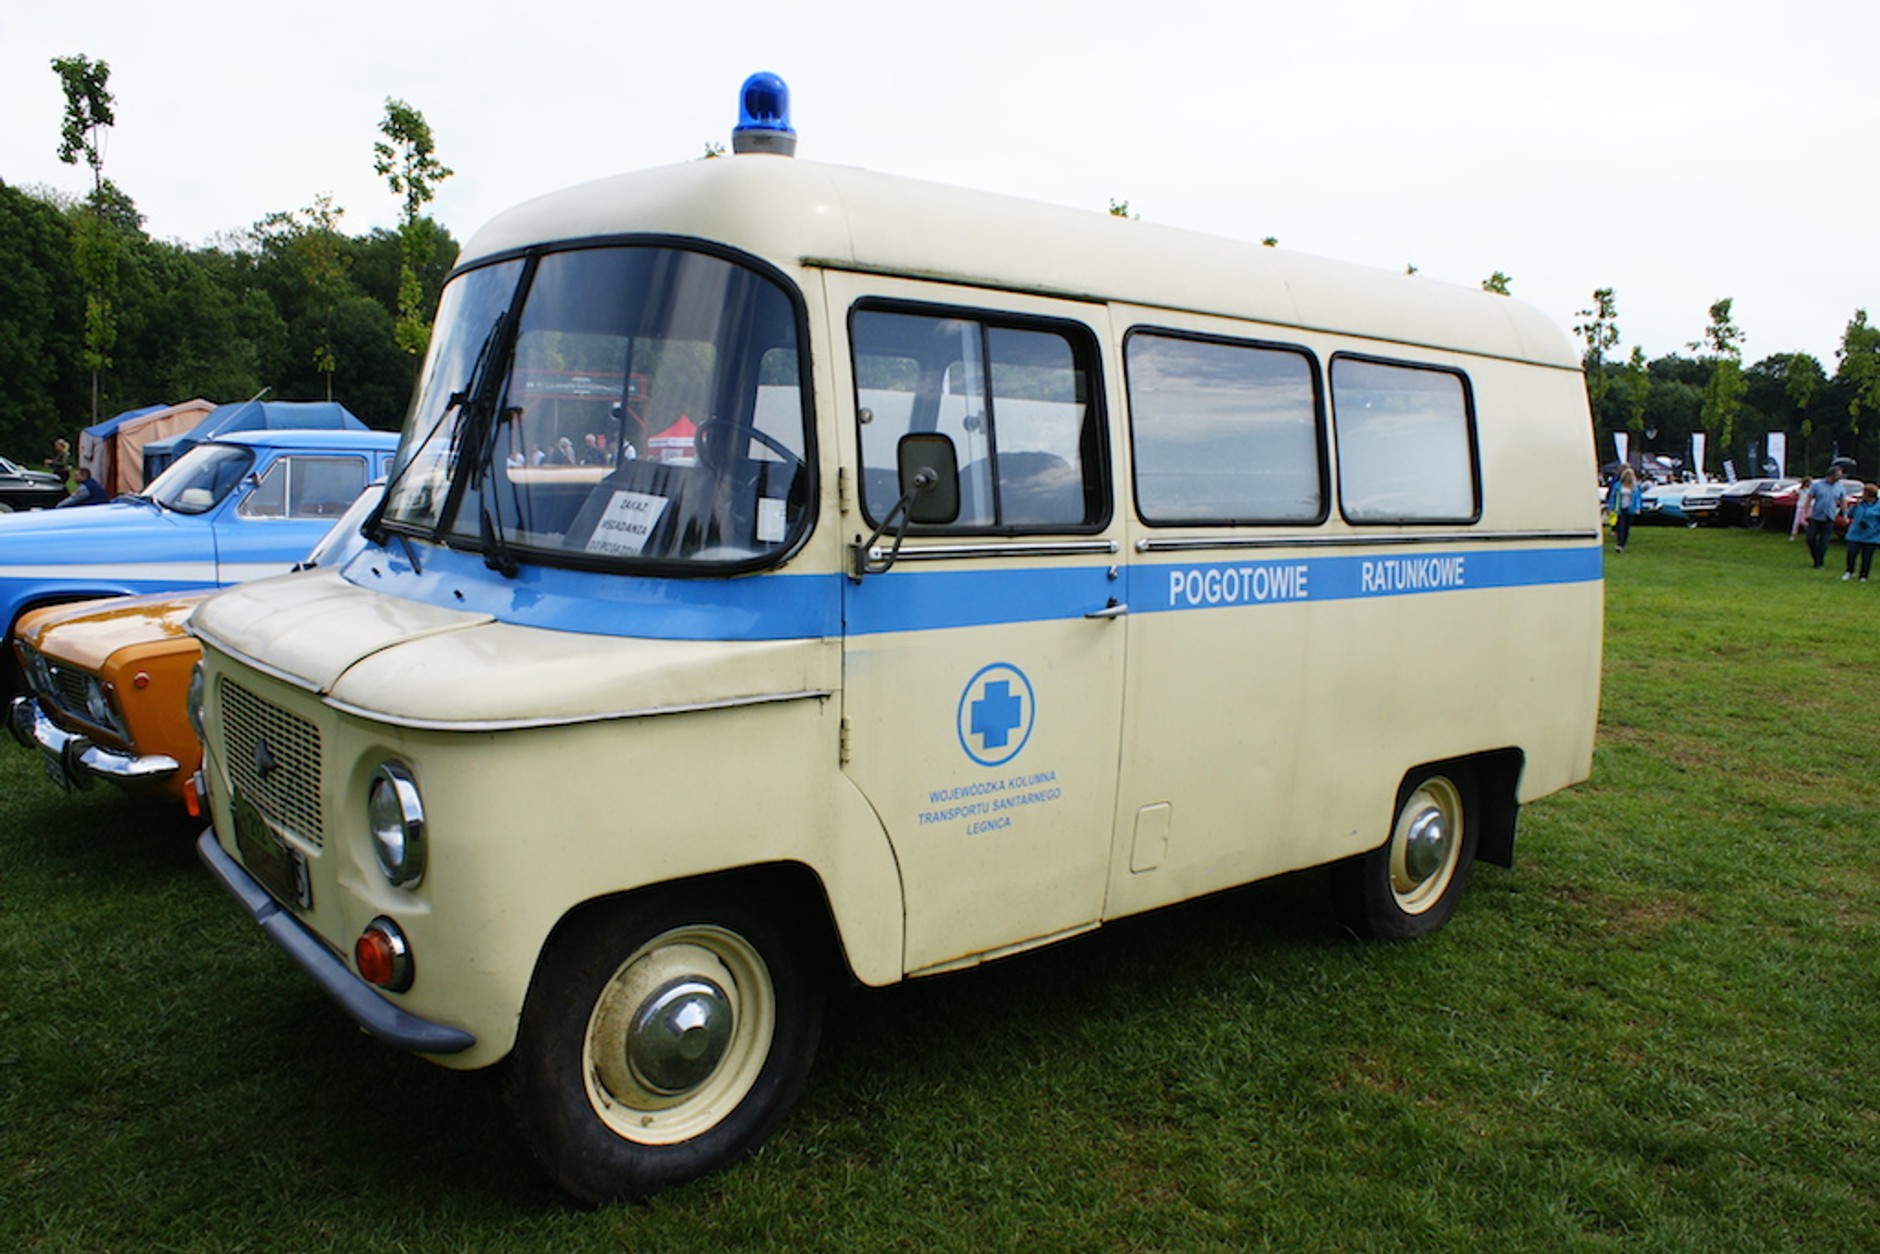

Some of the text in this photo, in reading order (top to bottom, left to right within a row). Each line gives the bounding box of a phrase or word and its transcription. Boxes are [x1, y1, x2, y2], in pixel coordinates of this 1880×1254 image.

[1170, 557, 1465, 605] POGOTOWIE RATUNKOWE
[1008, 770, 1056, 789] KOLUMNA
[918, 788, 1062, 825] TRANSPORTU SANITARNEGO
[966, 817, 1012, 836] LEGNICA
